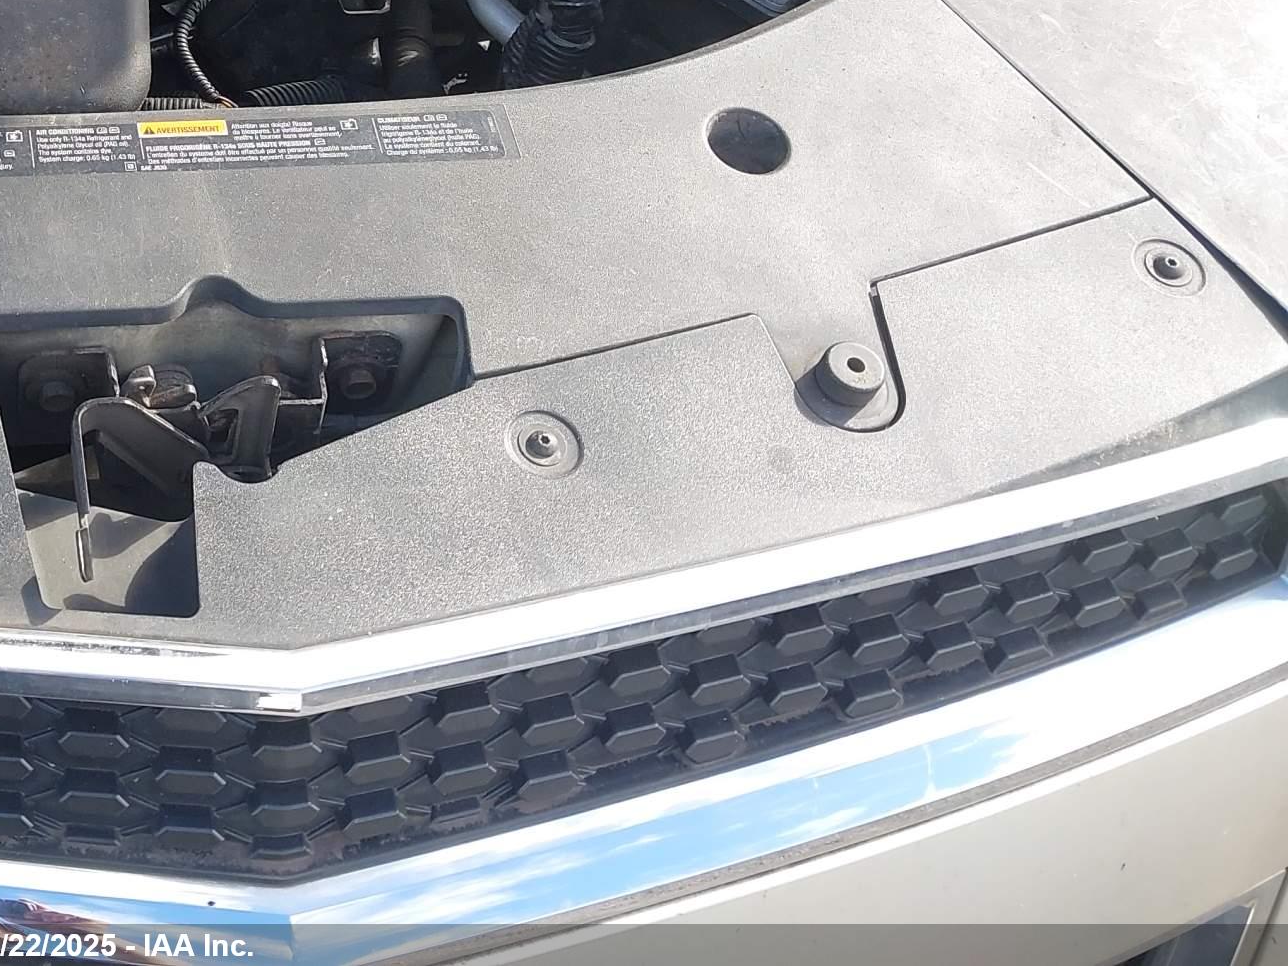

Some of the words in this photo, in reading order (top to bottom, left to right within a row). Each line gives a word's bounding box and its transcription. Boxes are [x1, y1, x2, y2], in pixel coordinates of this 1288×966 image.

[48, 127, 95, 135] CONDITIONING
[156, 125, 219, 134] AVERTISSEMENT
[38, 155, 62, 163] System
